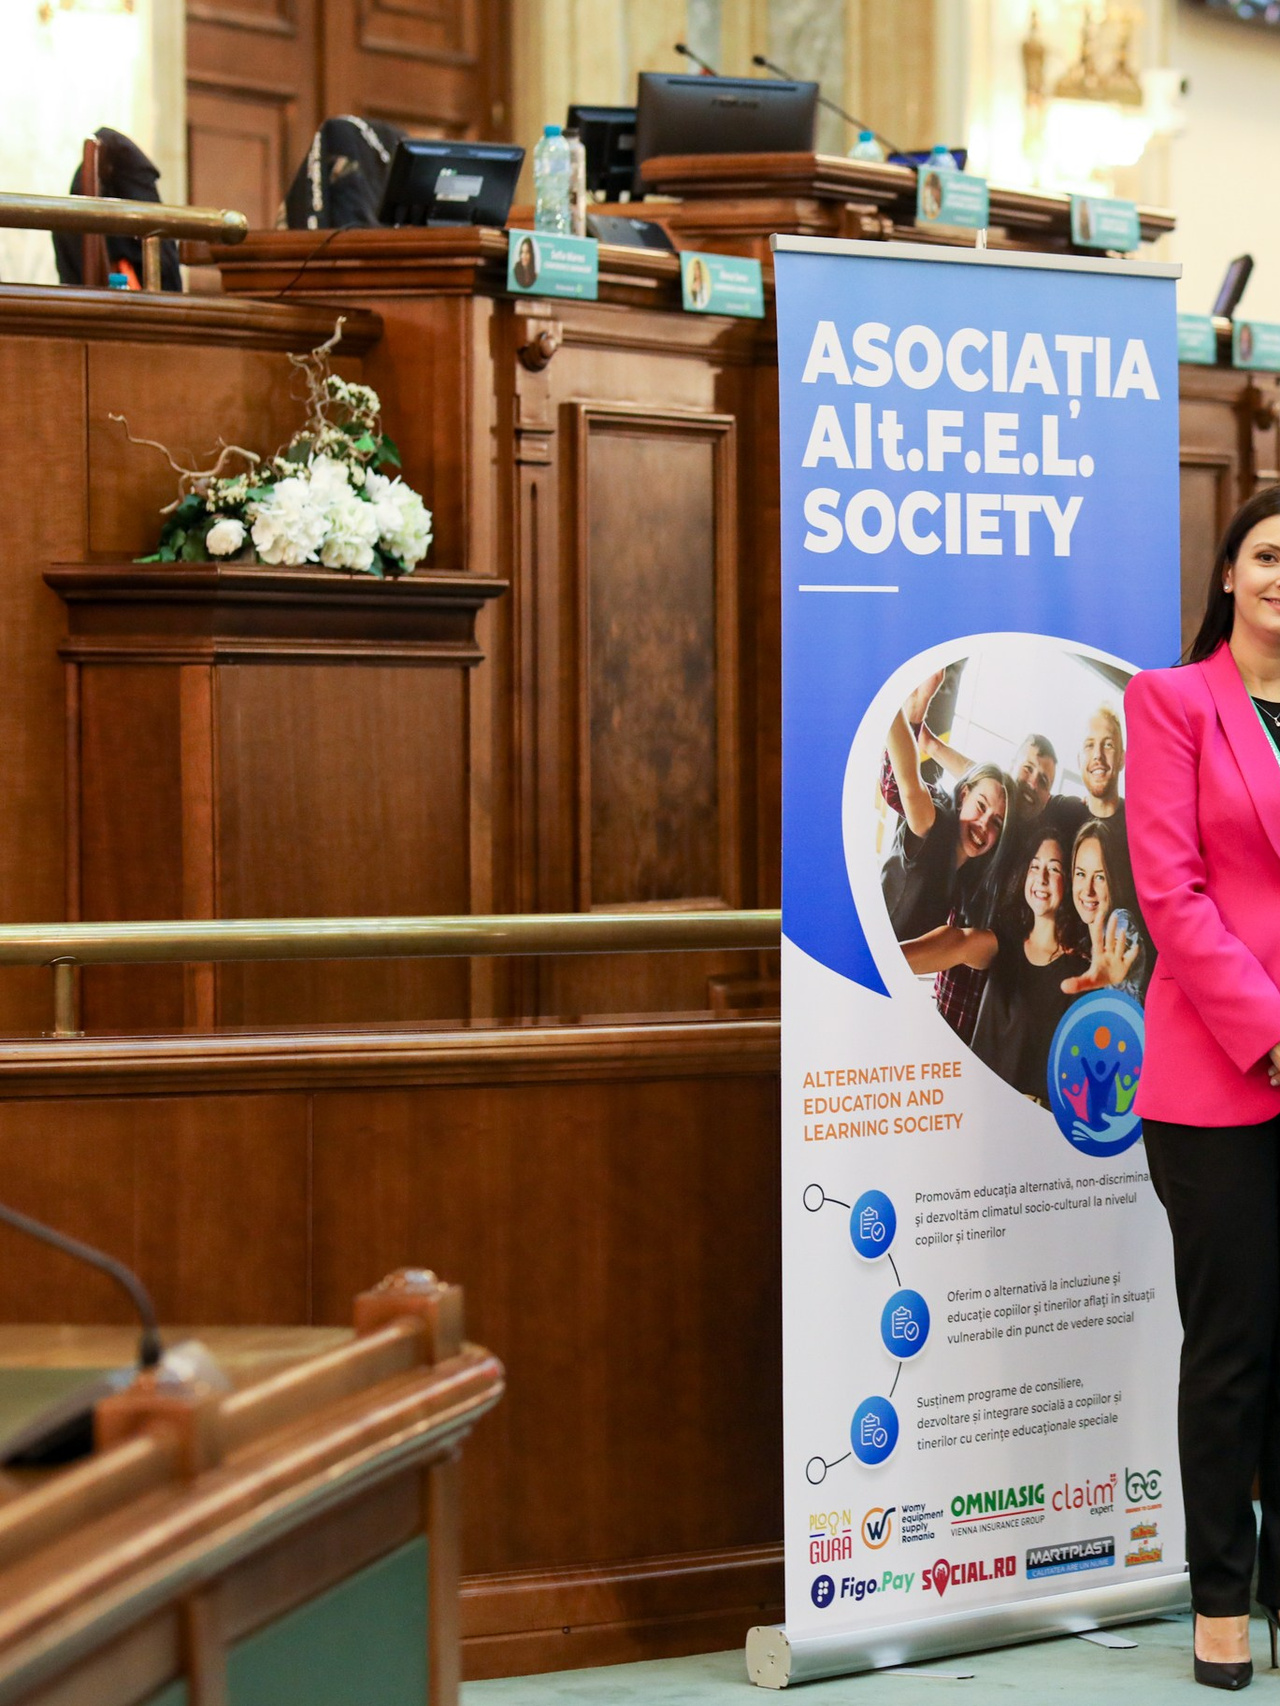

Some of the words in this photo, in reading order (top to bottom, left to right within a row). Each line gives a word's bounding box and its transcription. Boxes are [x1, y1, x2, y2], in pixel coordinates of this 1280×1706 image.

[801, 403, 1095, 478] Alt.F.E.L.
[803, 487, 1084, 556] SOCIETY
[803, 1064, 915, 1089] ALTERNATIVE
[921, 1061, 962, 1080] FREE
[803, 1091, 901, 1115] EDUCATION
[906, 1088, 944, 1107] AND
[804, 1118, 889, 1141] LEARNING
[893, 1113, 963, 1134] SOCIETY
[915, 1189, 971, 1203] Promovăm
[1075, 1172, 1151, 1188] non-discrimina
[926, 1208, 979, 1224] dezvoltăm
[982, 1202, 1023, 1217] climatul
[1025, 1196, 1091, 1214] socio-cultural
[1093, 1196, 1103, 1207] la
[1105, 1192, 1137, 1206] nivelul
[915, 1231, 953, 1247] copiilor
[966, 1226, 1006, 1241] tinerilor
[947, 1287, 982, 1303] Oferim
[984, 1289, 992, 1299] o
[993, 1281, 1047, 1297] alternativă
[1049, 1280, 1058, 1291] la
[1060, 1275, 1110, 1290] incluziune
[993, 1303, 1031, 1320] copiilor
[1043, 1294, 1082, 1311] tinerilor
[947, 1327, 1003, 1345] vulnerabile
[1006, 1324, 1023, 1337] din
[1024, 1322, 1055, 1338] punct
[1056, 1319, 1069, 1331] de
[1071, 1315, 1104, 1330] vedere
[1106, 1311, 1135, 1325] social
[967, 1386, 1017, 1404] programe
[1019, 1382, 1032, 1395] de
[1034, 1377, 1084, 1393] consiliere,
[917, 1413, 970, 1429] dezvoltare
[983, 1405, 1029, 1421] integrare
[1067, 1400, 1074, 1409] a
[1075, 1393, 1111, 1411] copiilor
[917, 1433, 957, 1451] tinerilor
[959, 1433, 972, 1445] cu
[1078, 1412, 1119, 1430] speciale
[902, 1503, 926, 1514] Womy
[950, 1483, 1045, 1517] OMNIASIG
[1052, 1479, 1114, 1512] claim
[902, 1510, 944, 1524] equipment
[1090, 1504, 1114, 1517] expert
[902, 1522, 928, 1534] supply
[902, 1531, 935, 1543] Romania
[951, 1525, 978, 1537] VIENNA
[979, 1519, 1020, 1534] INSURANCE
[1021, 1515, 1046, 1527] GROUP
[809, 1536, 852, 1564] GURA
[1029, 1539, 1112, 1566] MARTPLAST
[840, 1570, 916, 1601] Figo.Pay
